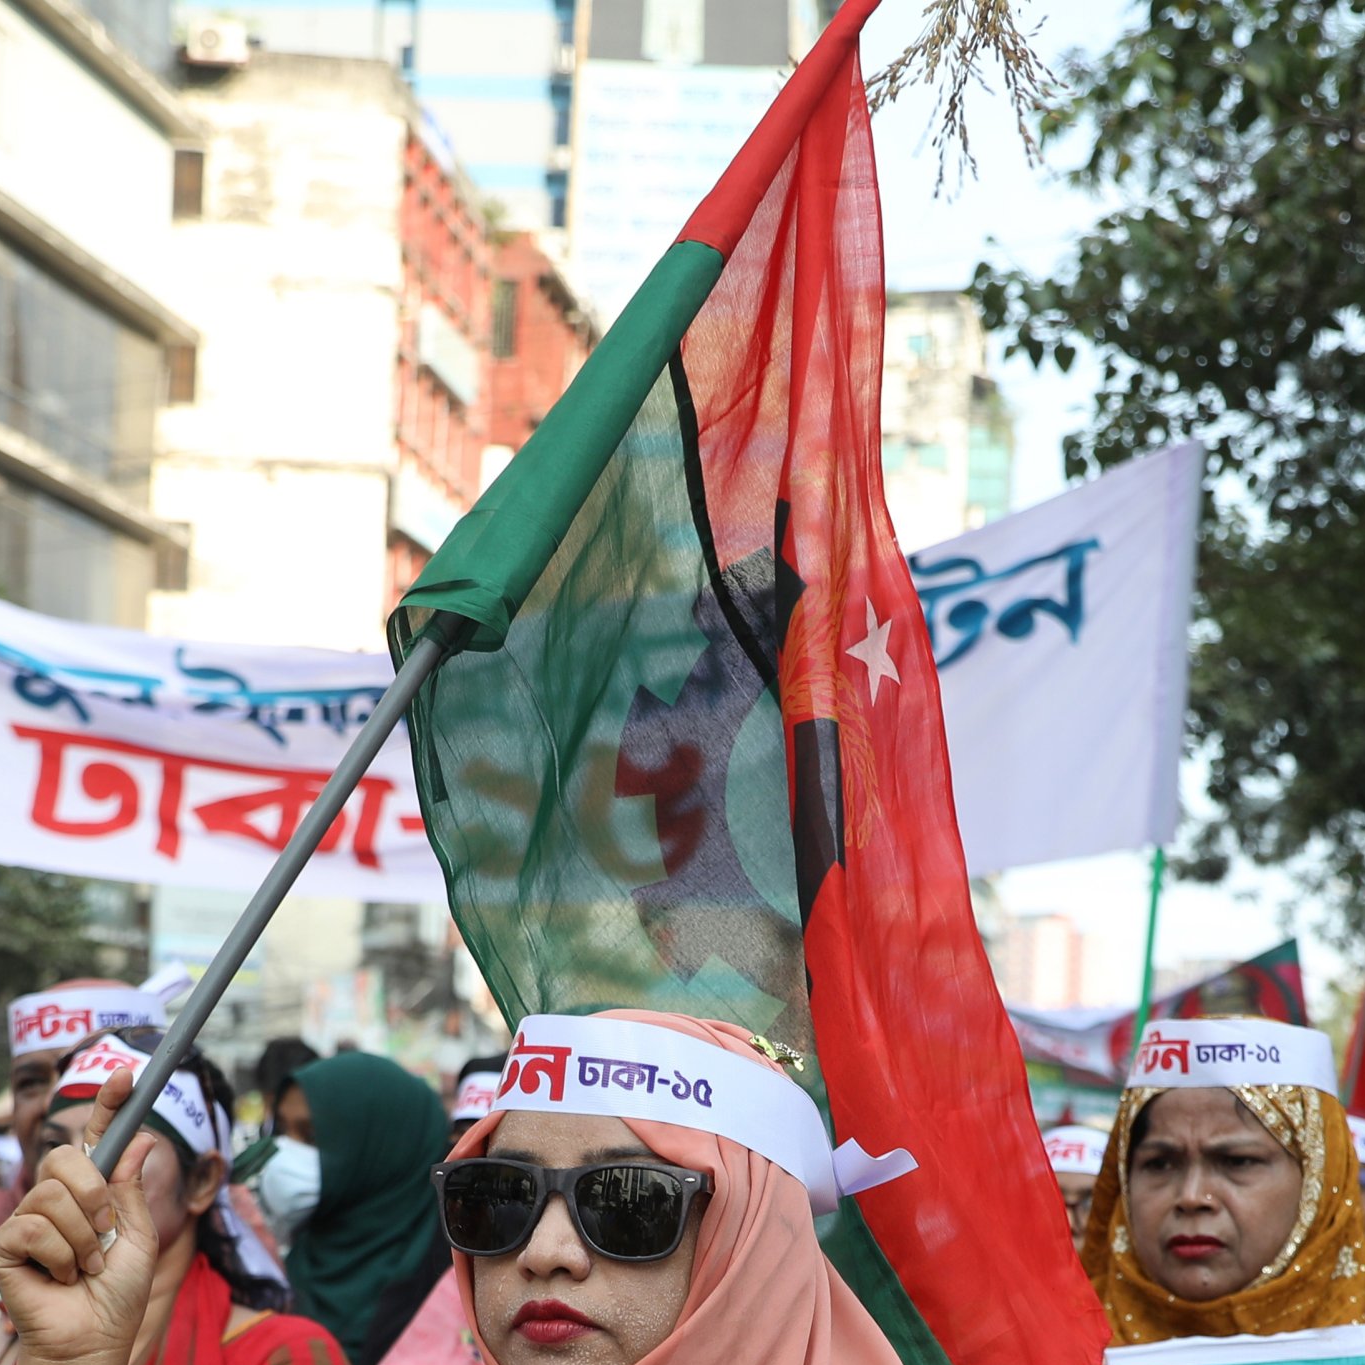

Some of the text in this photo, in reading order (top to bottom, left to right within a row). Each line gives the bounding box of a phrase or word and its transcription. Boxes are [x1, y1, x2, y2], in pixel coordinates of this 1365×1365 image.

[907, 536, 1101, 672] টন
[497, 1031, 573, 1103] টন
[577, 1055, 714, 1110] ঢাকা-১৫
[1133, 1030, 1282, 1077] টন ঢাকা-১৫
